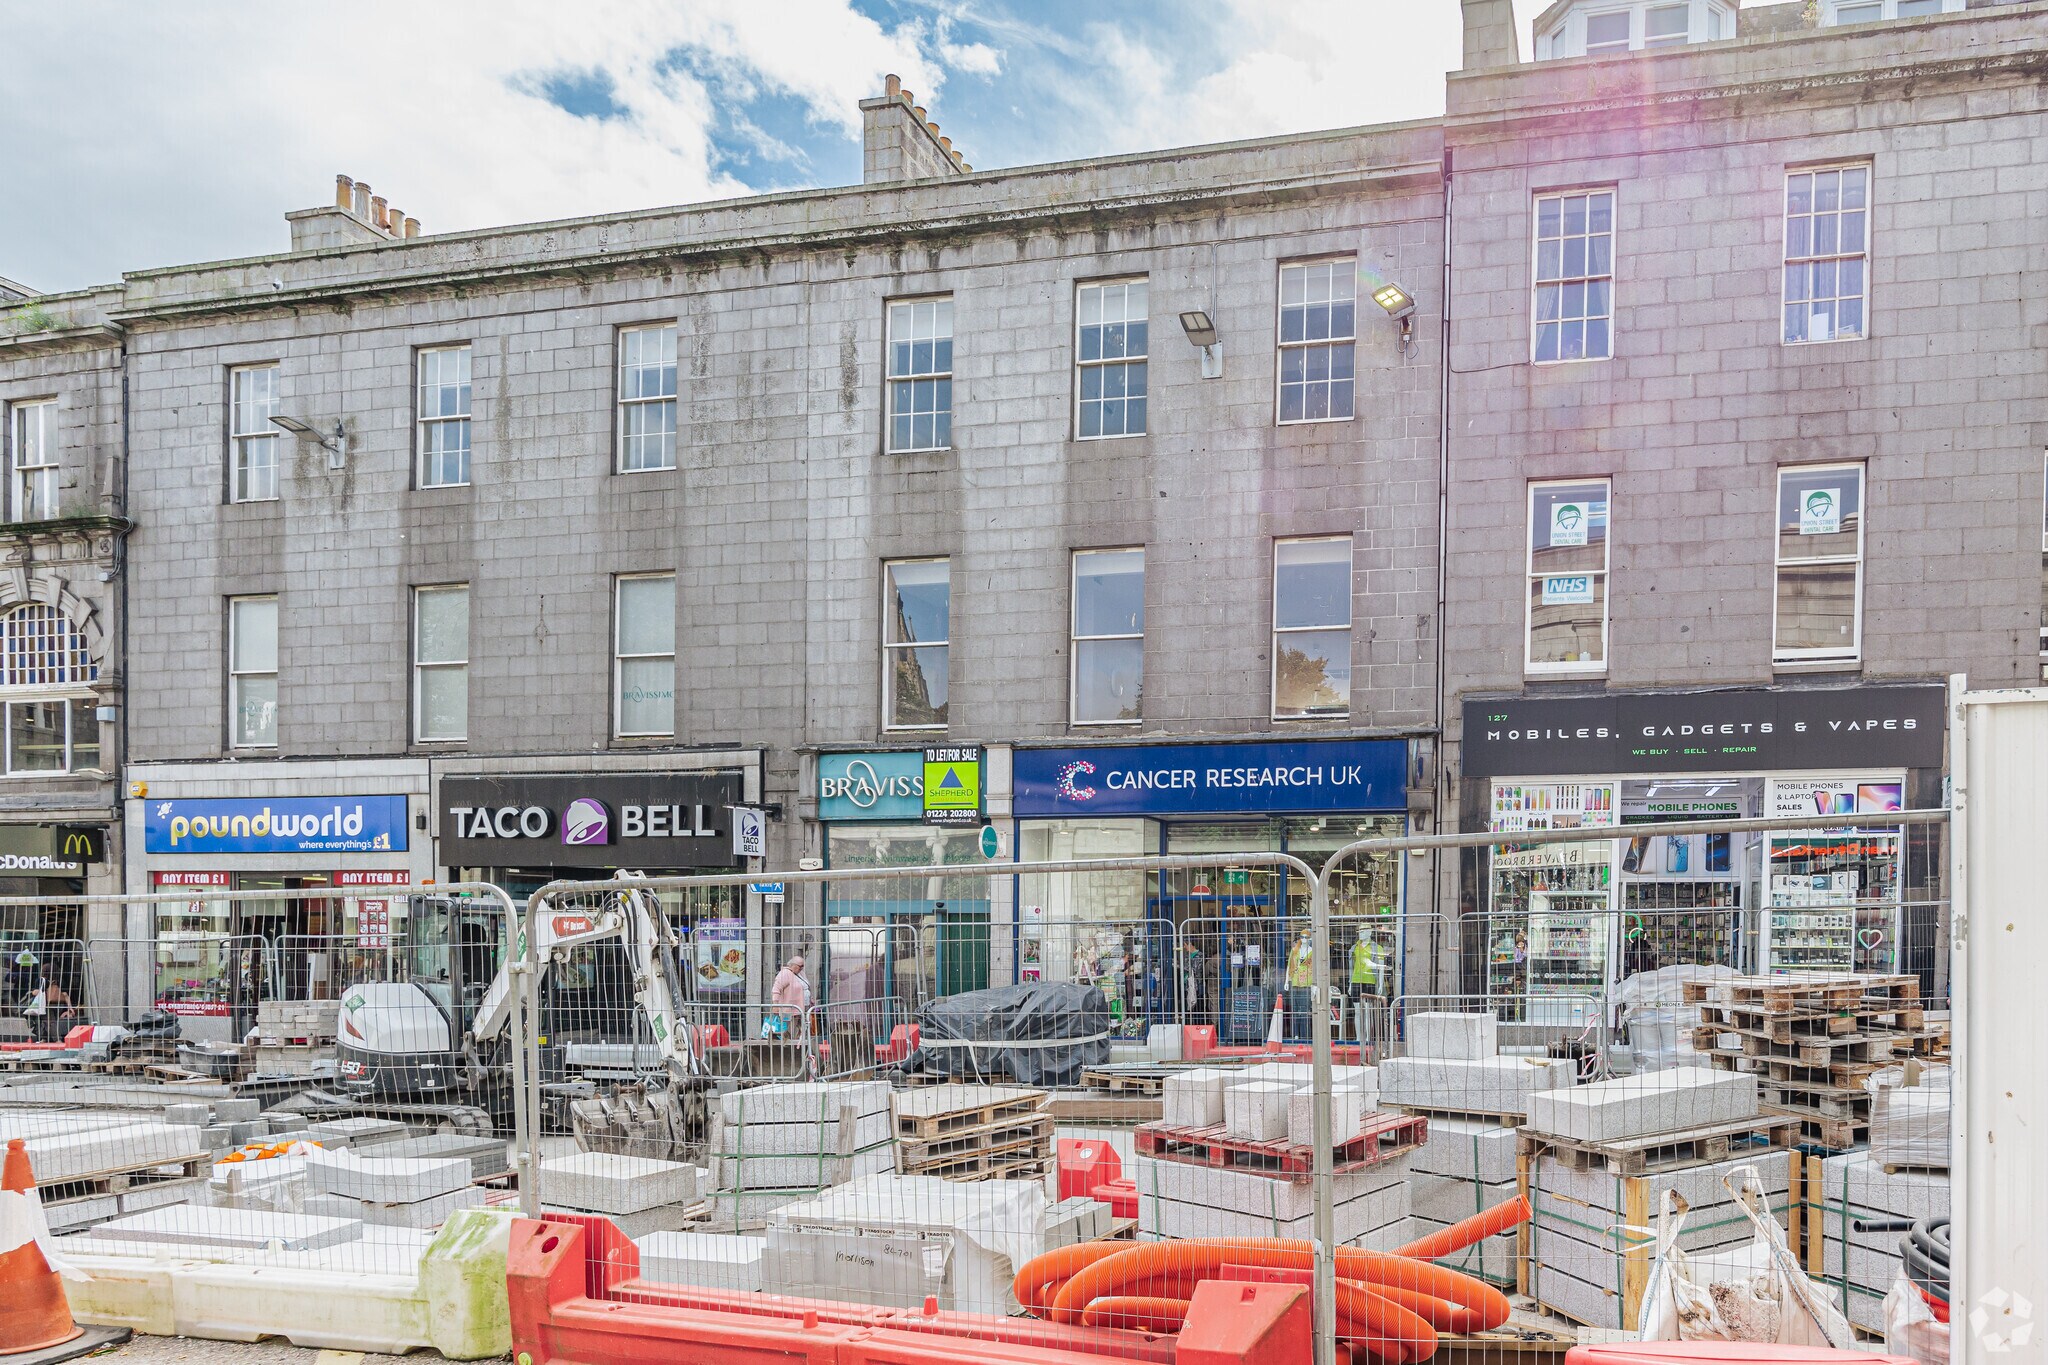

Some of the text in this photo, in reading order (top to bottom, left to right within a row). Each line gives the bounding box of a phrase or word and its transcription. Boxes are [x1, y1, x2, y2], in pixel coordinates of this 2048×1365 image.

[1549, 578, 1586, 593] NHS
[1487, 714, 1508, 722] 127
[1642, 722, 1773, 737] GADGETS
[1794, 722, 1807, 732] &
[1828, 718, 1917, 731] VAPES
[926, 750, 935, 762] TO
[962, 749, 977, 761] SALE
[822, 759, 923, 808] BRAVISS
[1106, 765, 1362, 790] CANCER RESEARCH UK
[929, 788, 974, 797] SHEPHERD
[1648, 802, 1738, 812] MOBILE PHONES
[926, 810, 948, 818] 01224
[170, 805, 363, 846] poundworld
[450, 804, 716, 839] TACO BELL
[298, 833, 391, 850] where everything's £1
[742, 836, 759, 845] TACO
[744, 844, 759, 852] BELL
[162, 874, 224, 884] ANY ITEM £1
[342, 872, 409, 883] ANY ITEM £1
